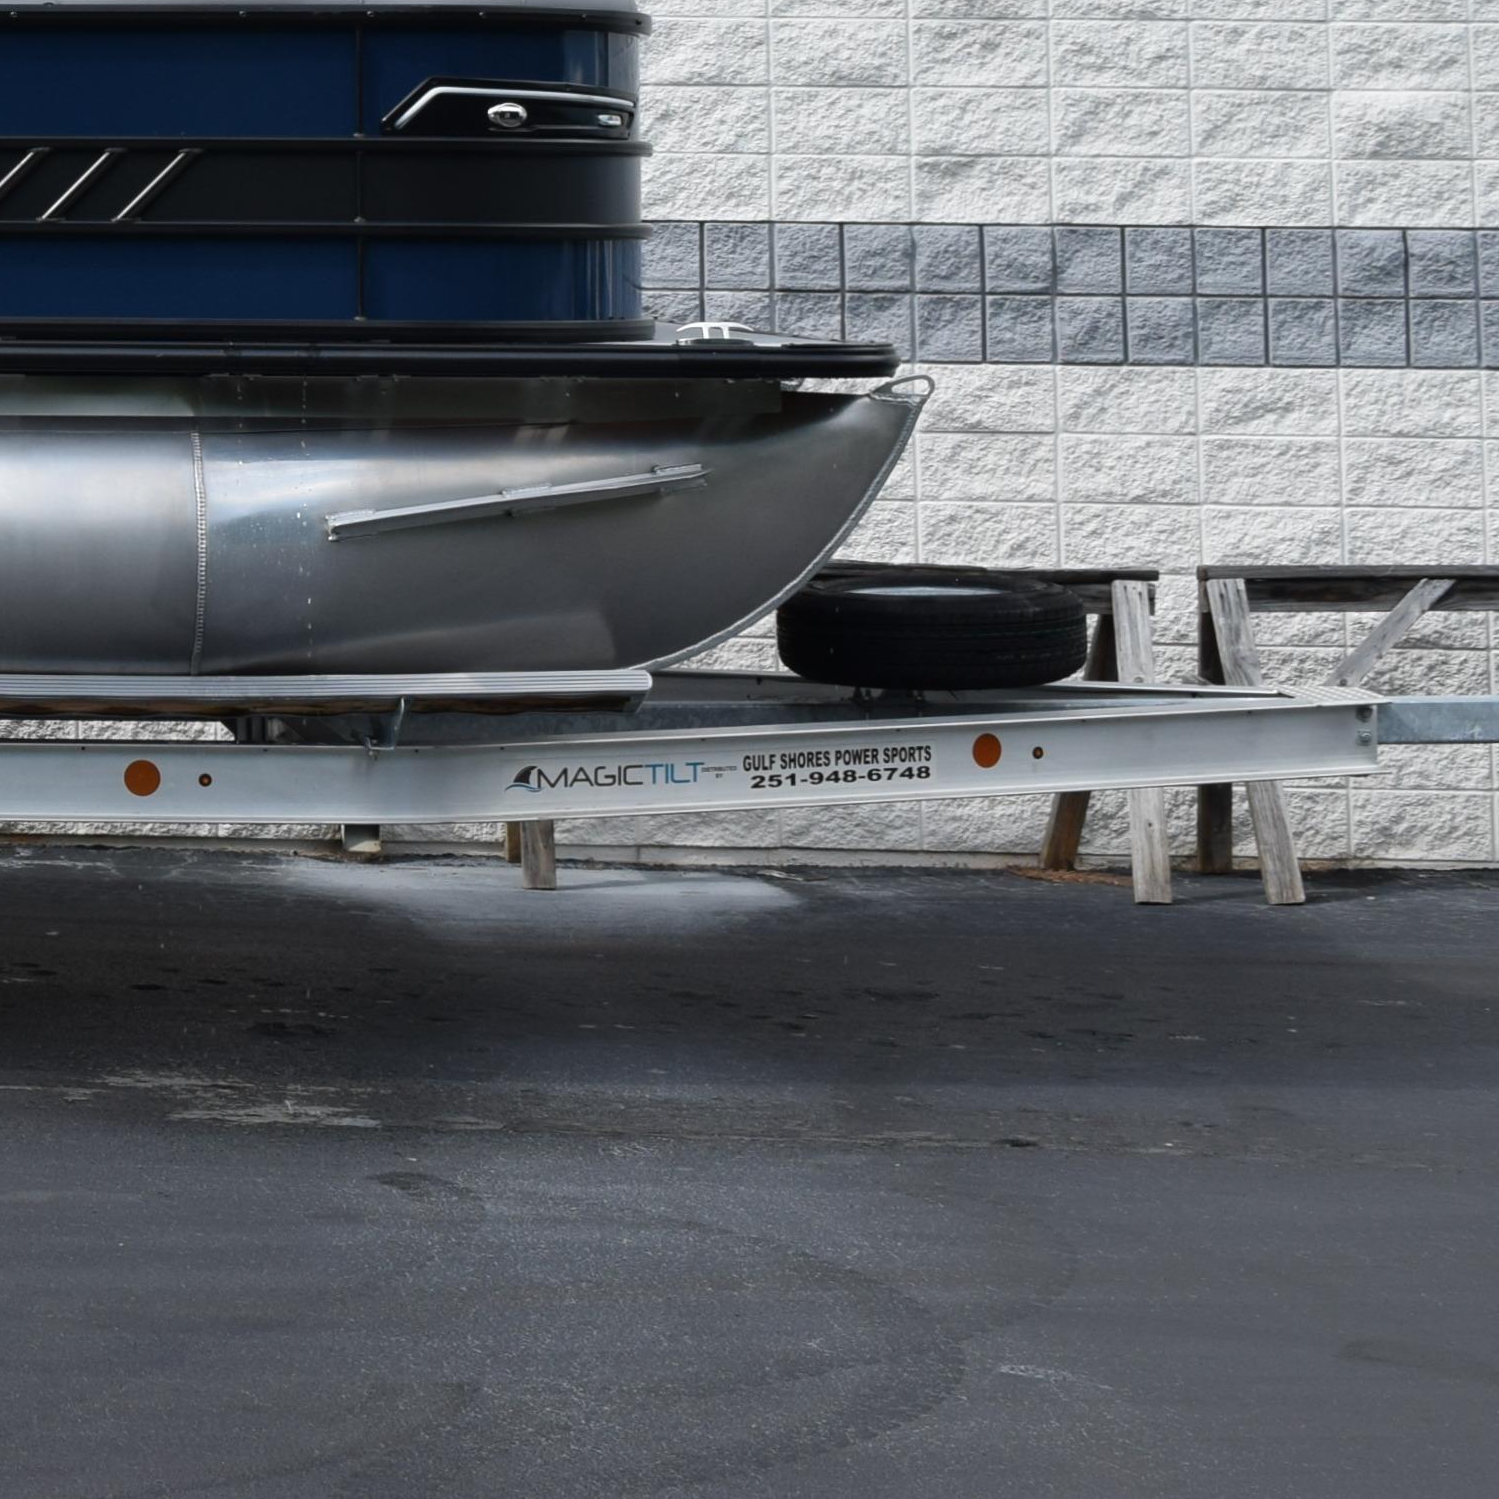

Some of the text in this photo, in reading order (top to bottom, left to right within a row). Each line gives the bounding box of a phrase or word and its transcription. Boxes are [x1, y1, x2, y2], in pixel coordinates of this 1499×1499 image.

[743, 745, 932, 772] GULF SHORES POWER SPORTS
[537, 762, 705, 788] MAGICTILT
[750, 766, 931, 789] 251-948-6748
